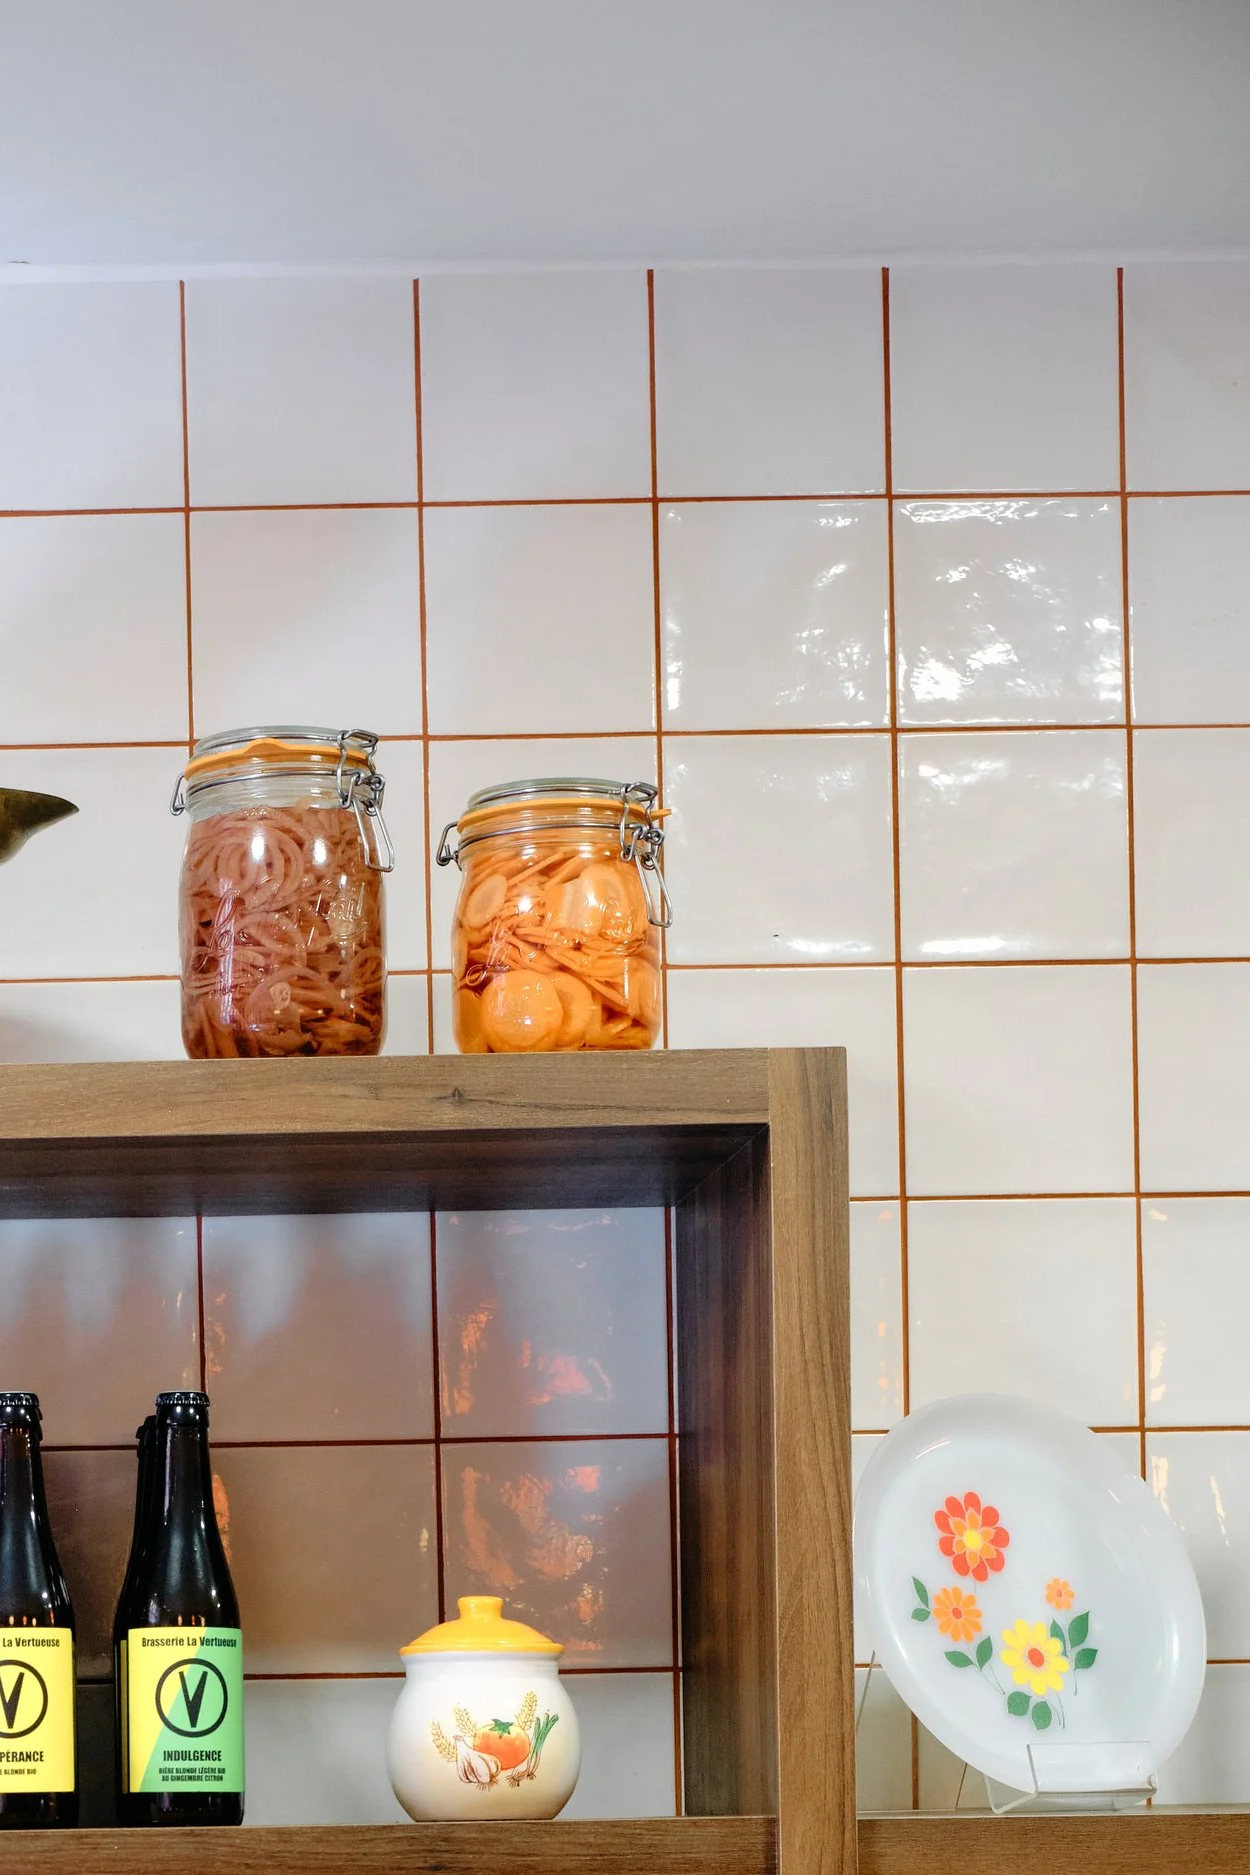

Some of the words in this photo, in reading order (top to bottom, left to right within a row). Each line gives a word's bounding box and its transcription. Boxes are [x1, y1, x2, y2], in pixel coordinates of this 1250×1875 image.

[3, 1638, 12, 1647] La
[15, 1638, 60, 1647] Vertueuse
[142, 1637, 184, 1647] Brasserie
[187, 1637, 196, 1646] La
[200, 1637, 237, 1647] Vertueuse
[163, 1751, 222, 1761] INDULGENCE
